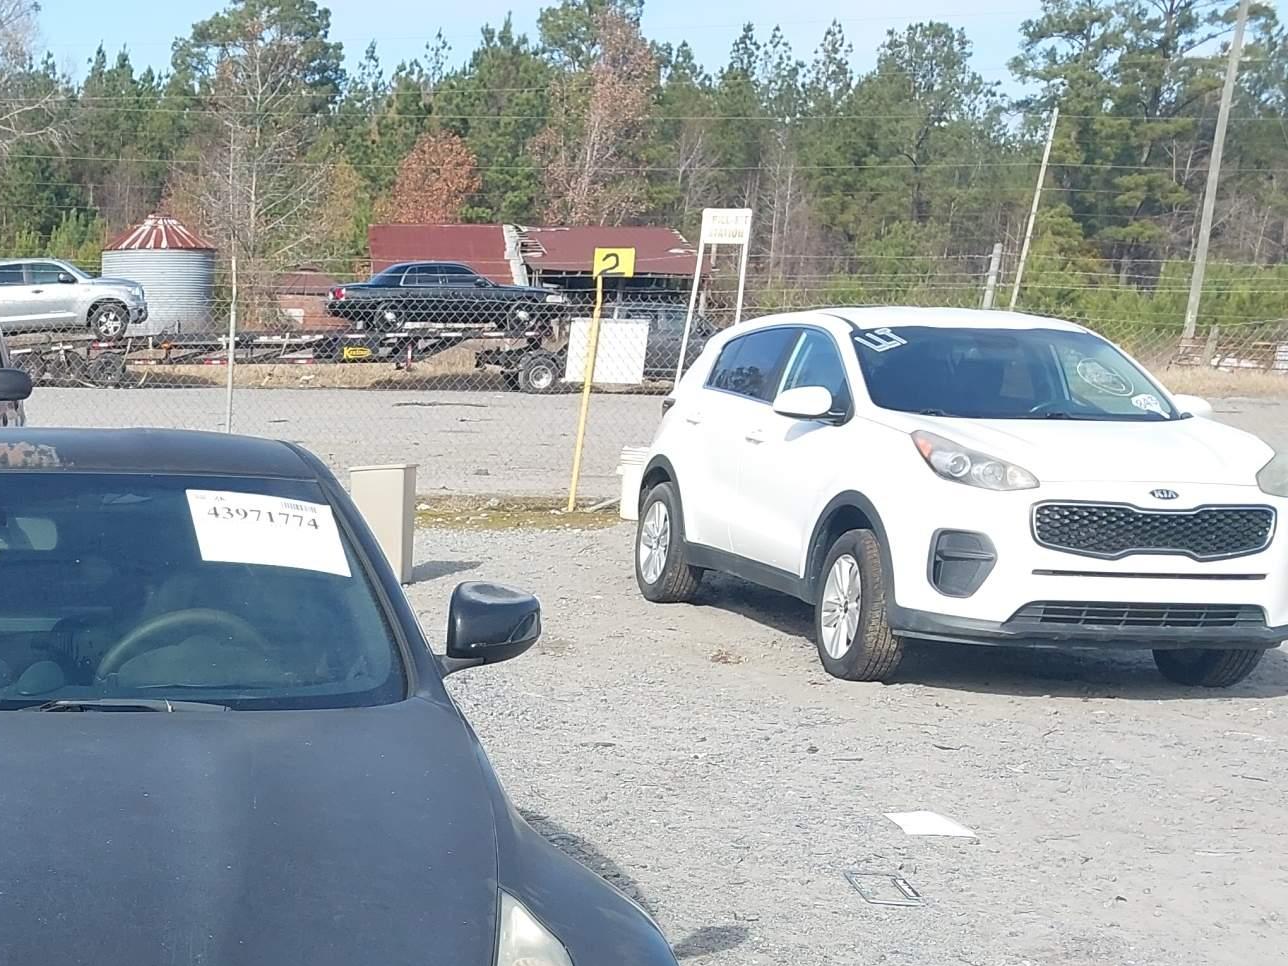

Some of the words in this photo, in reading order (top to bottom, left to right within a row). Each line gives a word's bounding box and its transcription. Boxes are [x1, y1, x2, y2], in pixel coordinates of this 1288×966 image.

[596, 252, 626, 276] 2
[1153, 489, 1177, 499] KIA
[207, 505, 320, 530] 43971774
